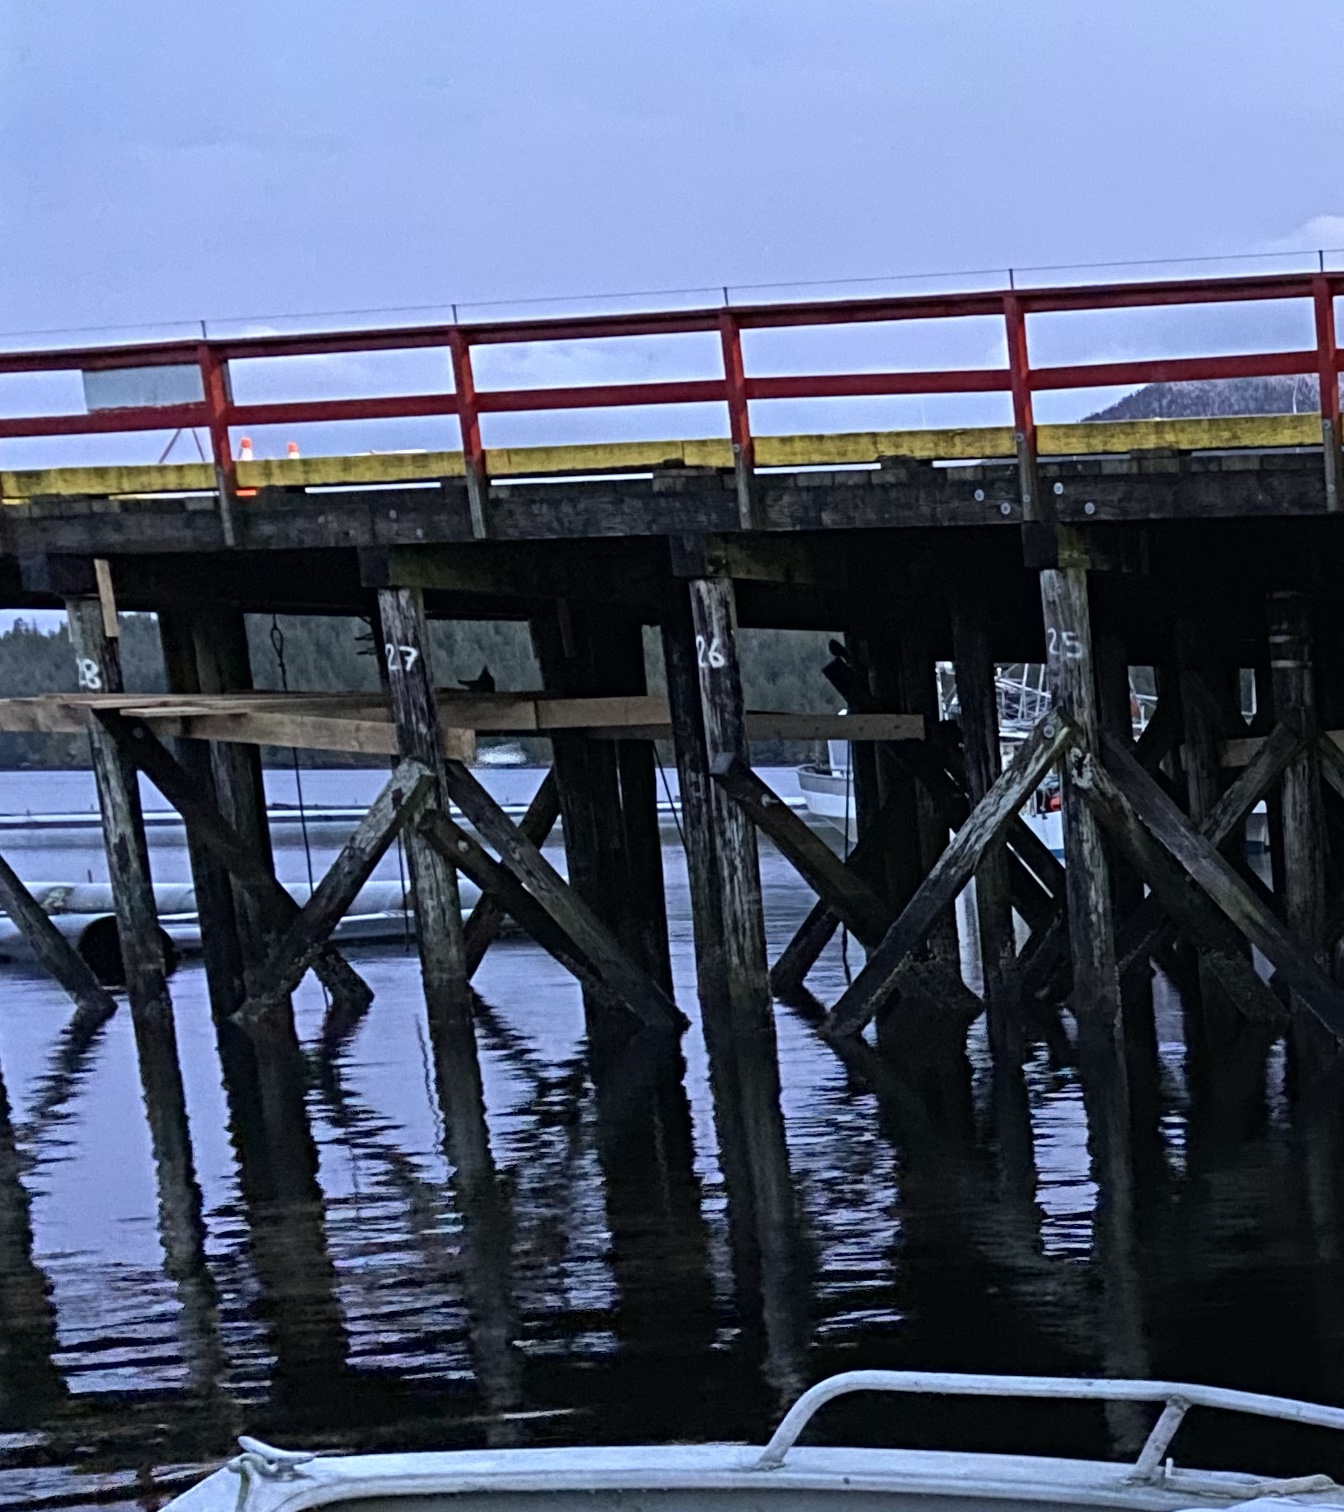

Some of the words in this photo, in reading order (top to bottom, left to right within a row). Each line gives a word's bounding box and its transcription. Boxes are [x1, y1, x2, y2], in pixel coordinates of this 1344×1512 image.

[385, 643, 418, 672] 27
[696, 634, 725, 668] 26
[1047, 627, 1083, 658] 25
